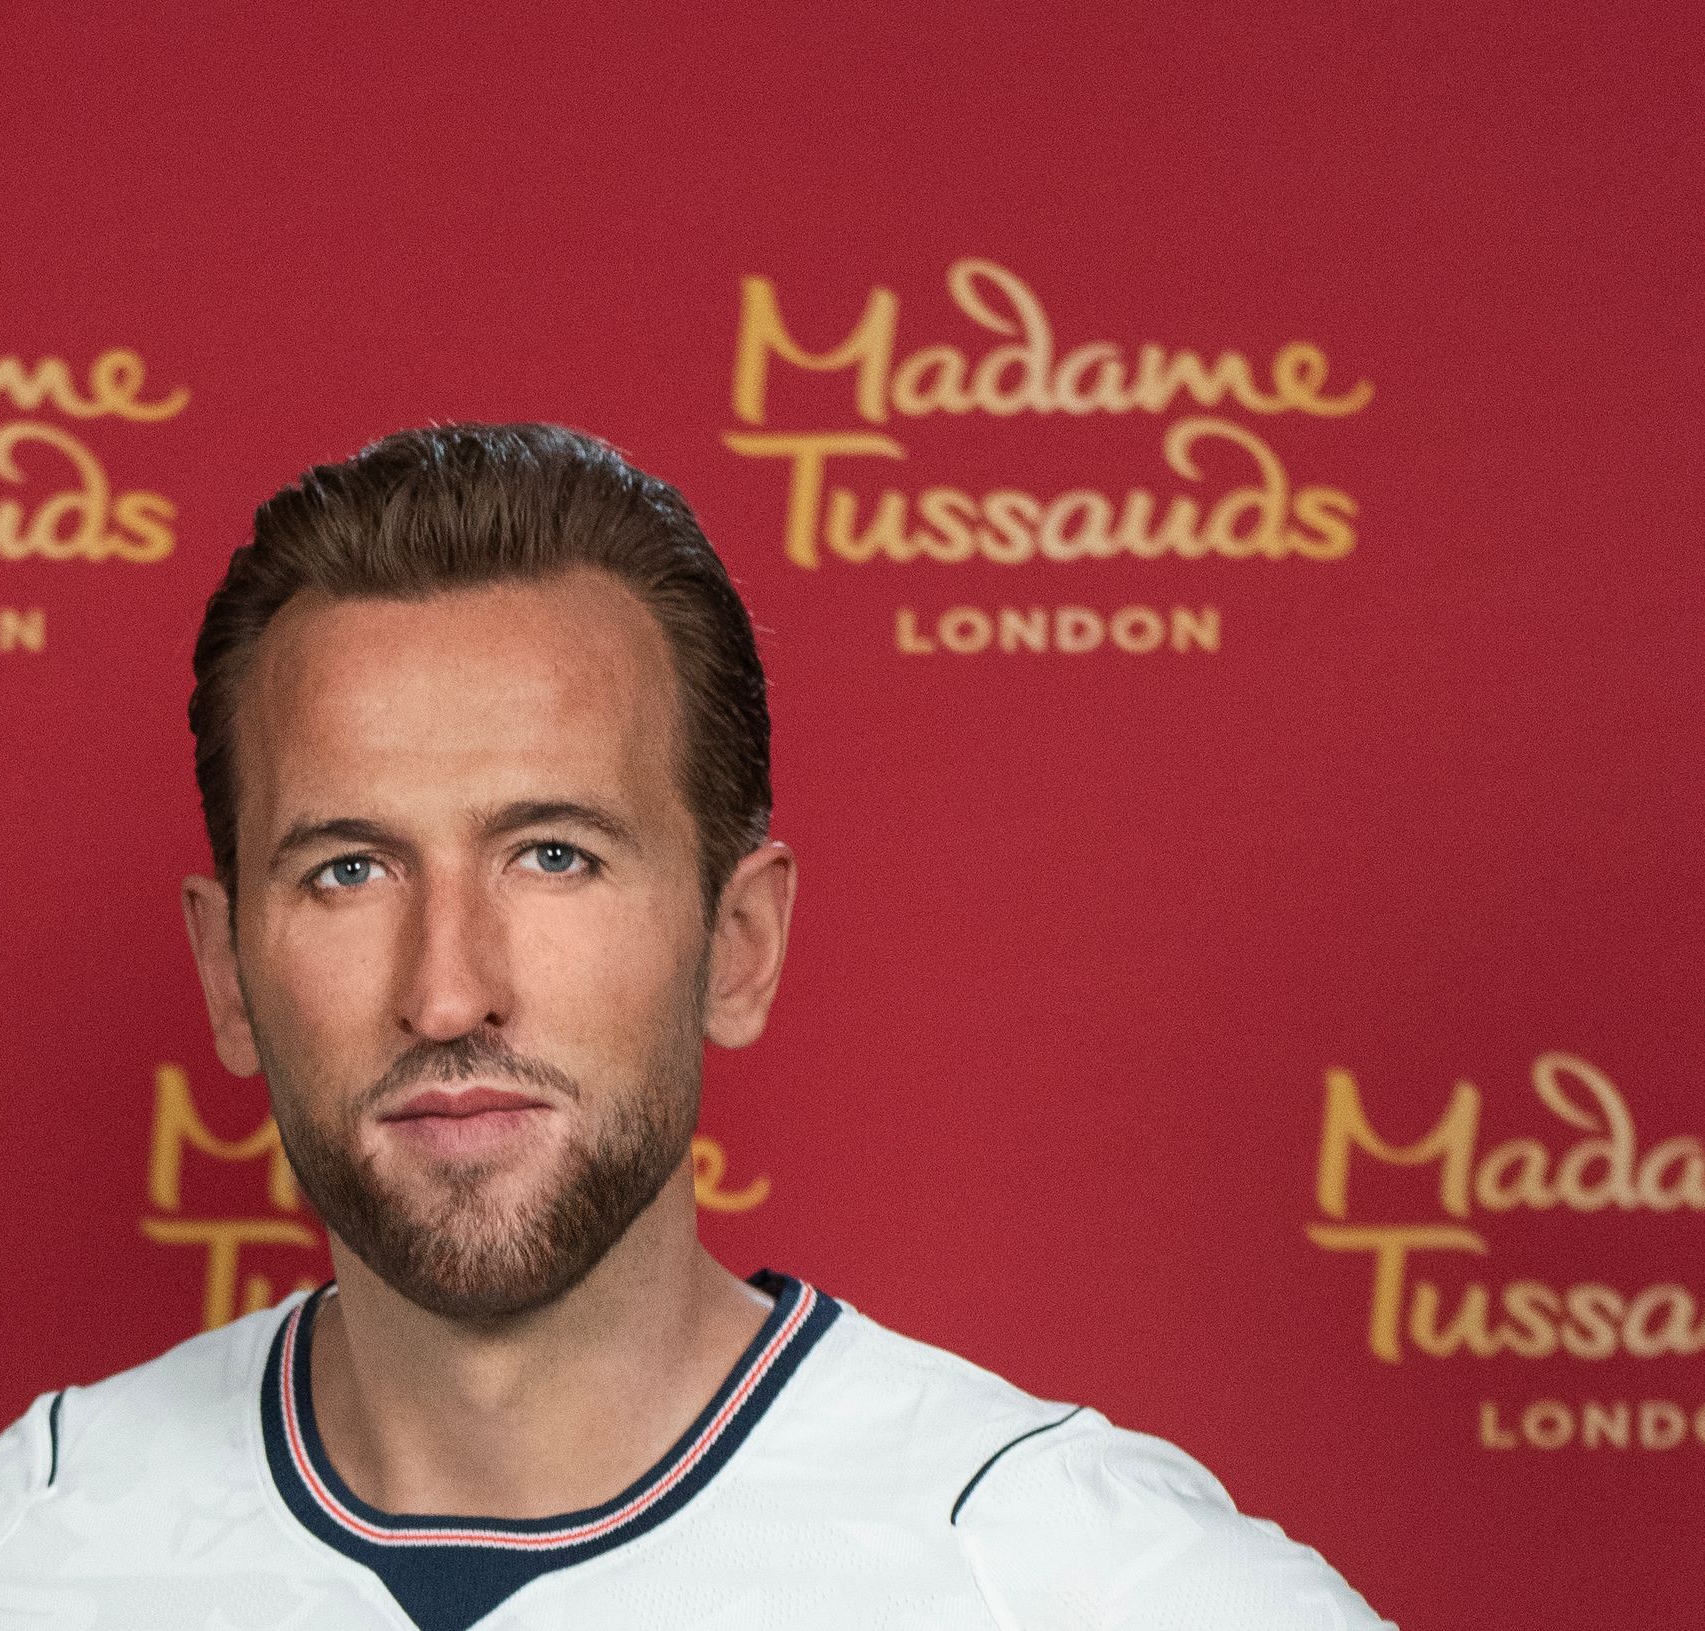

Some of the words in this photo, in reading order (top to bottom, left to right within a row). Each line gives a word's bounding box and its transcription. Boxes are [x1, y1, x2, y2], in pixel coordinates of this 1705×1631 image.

[731, 257, 1374, 424] Madame
[722, 417, 1358, 569] Tussauds
[894, 605, 1222, 655] LONDON
[1478, 1400, 1705, 1450] LOND
